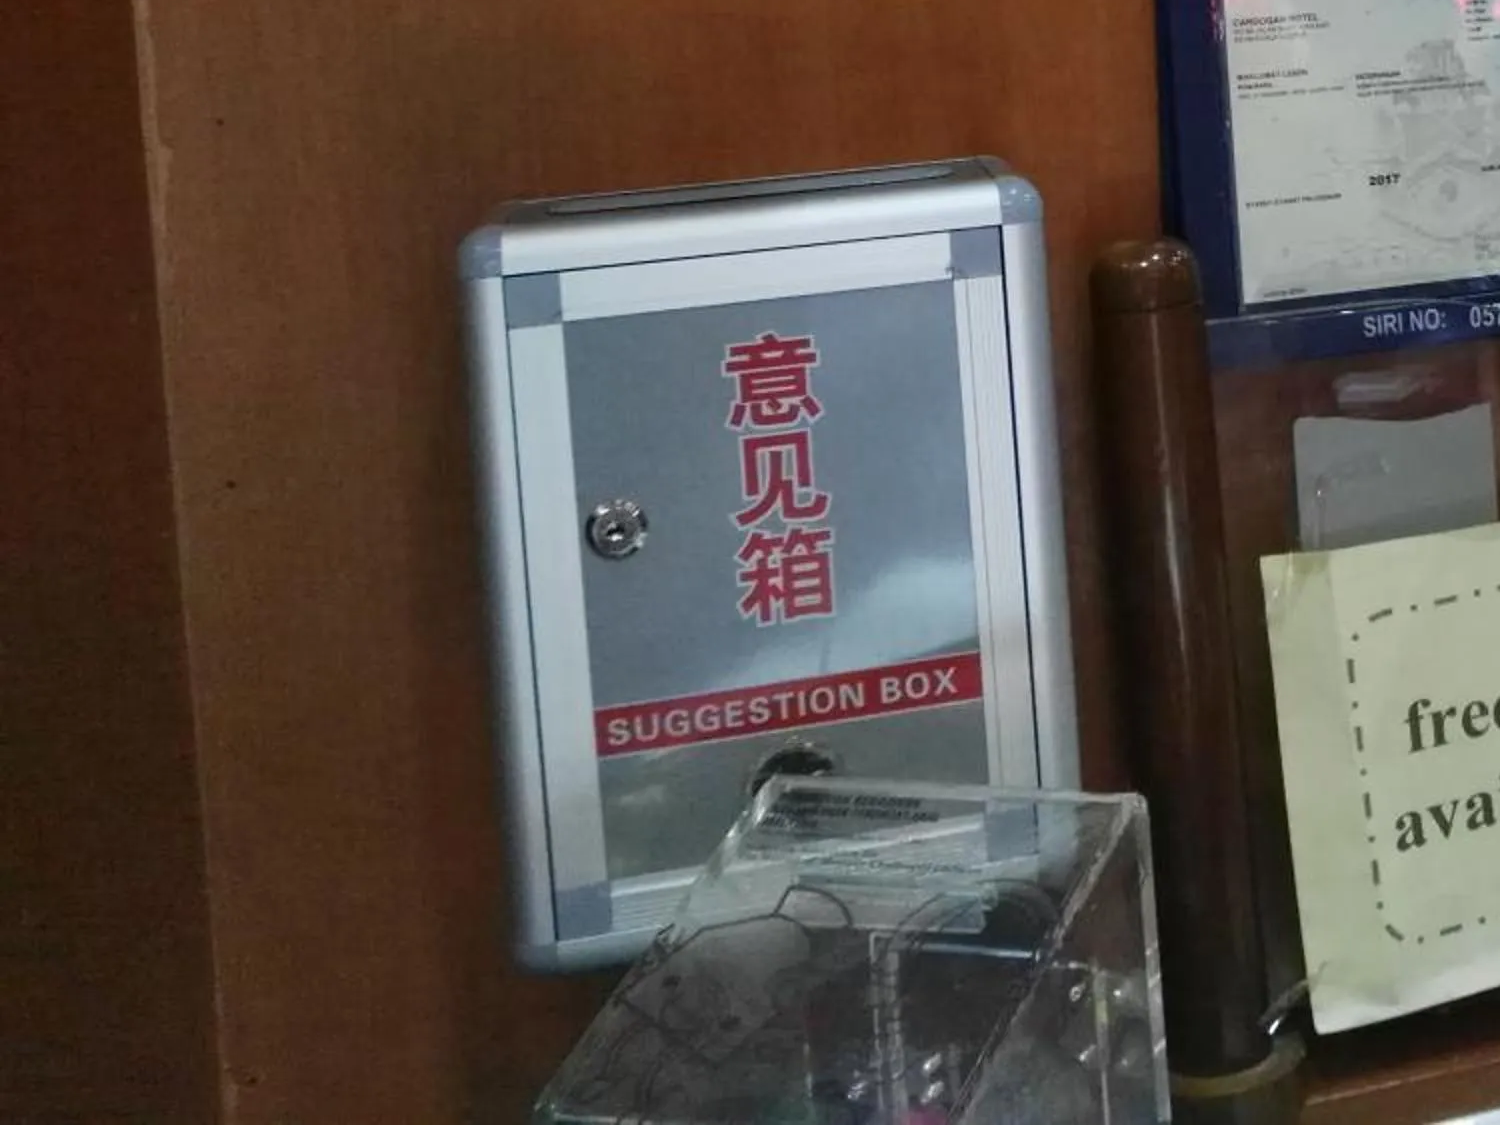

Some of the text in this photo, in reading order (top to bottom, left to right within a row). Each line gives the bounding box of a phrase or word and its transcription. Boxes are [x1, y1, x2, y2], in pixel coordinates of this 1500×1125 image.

[1368, 173, 1401, 188] 2017
[1363, 311, 1404, 339] SIRI
[1408, 307, 1447, 335] NO:
[721, 331, 836, 627] 意见箱
[607, 667, 958, 747] SUGGESTION BOX
